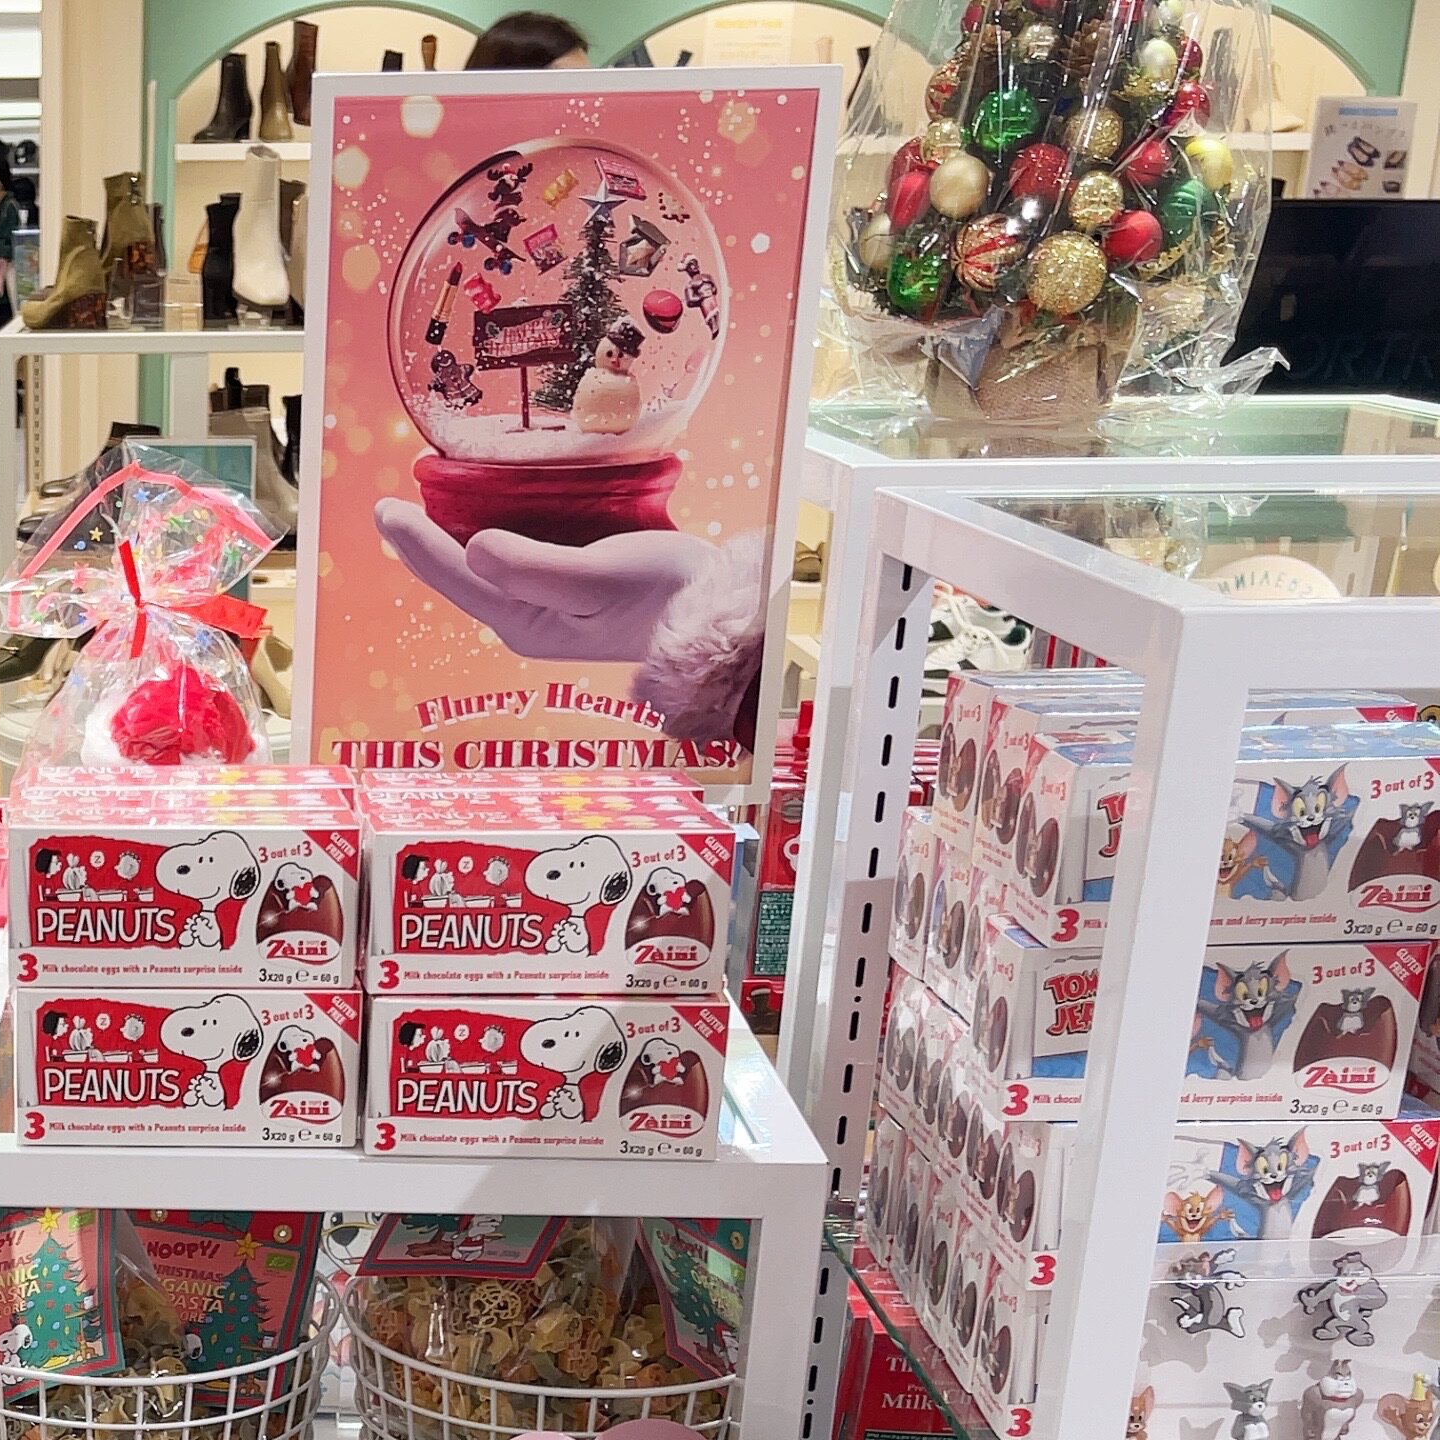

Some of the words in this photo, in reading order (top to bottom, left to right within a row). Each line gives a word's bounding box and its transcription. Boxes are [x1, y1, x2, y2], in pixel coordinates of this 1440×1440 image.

[414, 686, 537, 732] Flurry
[546, 682, 666, 731] Hearts
[331, 739, 445, 771] THIS
[454, 738, 742, 772] CHRISTMAS!
[259, 846, 268, 863] 3
[271, 848, 287, 859] out
[291, 845, 301, 857] of
[303, 841, 312, 857] 3
[35, 907, 177, 943] PEANUTS
[400, 914, 543, 949] PEANUTS
[1052, 908, 1080, 942] 3
[16, 953, 38, 983] 3
[42, 964, 58, 974] Milk
[61, 963, 99, 974] chocolate
[101, 965, 120, 976] eggs
[122, 963, 140, 974] with
[149, 964, 182, 974] Peanuts
[184, 964, 216, 976] surprise
[218, 964, 243, 974] inside
[377, 960, 399, 989] 3
[1312, 965, 1323, 984] 3
[1326, 968, 1348, 978] out
[1350, 962, 1363, 975] of
[1365, 958, 1375, 976] 3
[626, 1023, 636, 1038] 3
[638, 1024, 655, 1035] out
[658, 1020, 669, 1032] of
[671, 1016, 681, 1032] 3
[44, 1068, 180, 1101] PEANUTS
[397, 1080, 539, 1113] PEANUTS
[1002, 1084, 1029, 1116] 3
[24, 1112, 45, 1140] 3
[374, 1123, 397, 1151] 3
[881, 1393, 934, 1410] Milk
